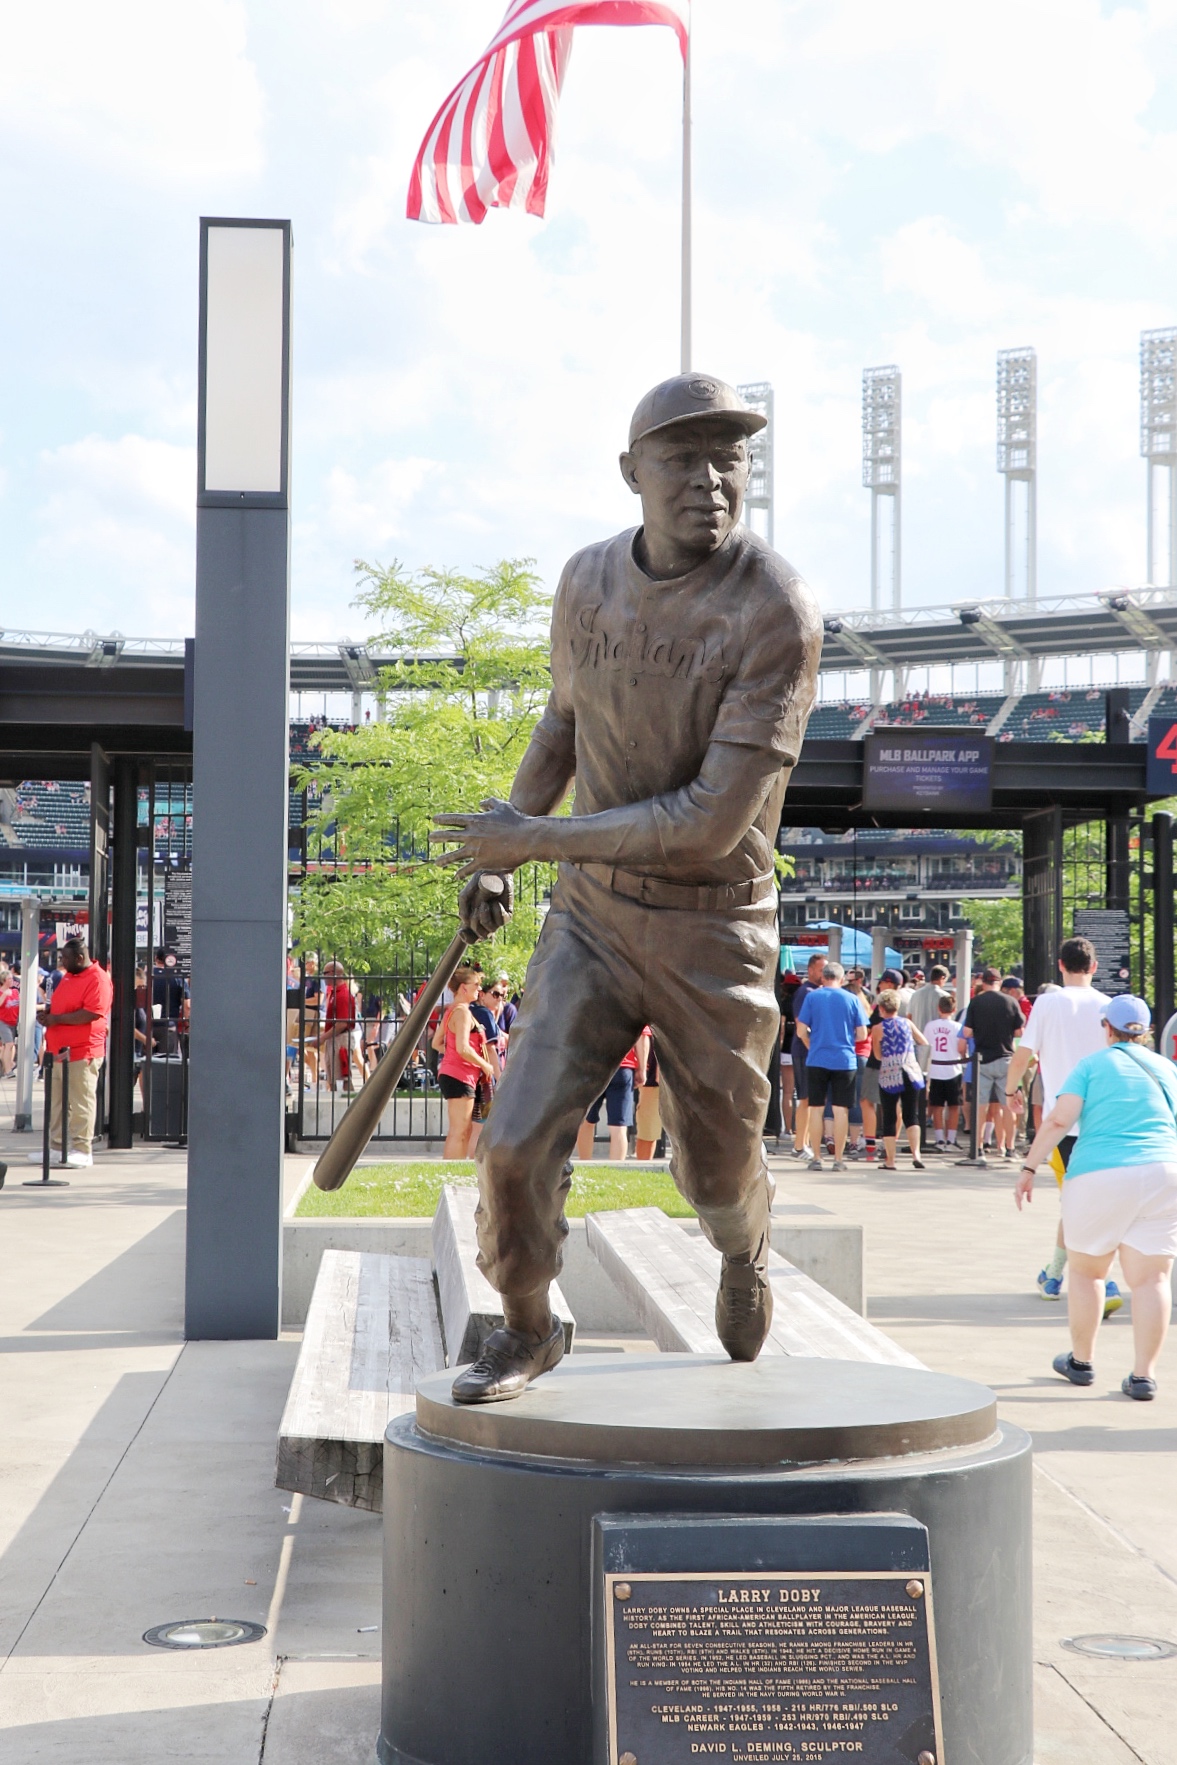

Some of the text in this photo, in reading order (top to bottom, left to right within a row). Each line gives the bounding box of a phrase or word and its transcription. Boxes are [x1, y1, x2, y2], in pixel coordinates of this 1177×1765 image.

[570, 603, 728, 682] Indians
[880, 750, 979, 762] MLB BALLPARK APP
[935, 1036, 948, 1052] 12
[719, 1589, 820, 1602] LARRY DOBY
[691, 1742, 862, 1753] DAVID L. DEMING, SCULPTOR
